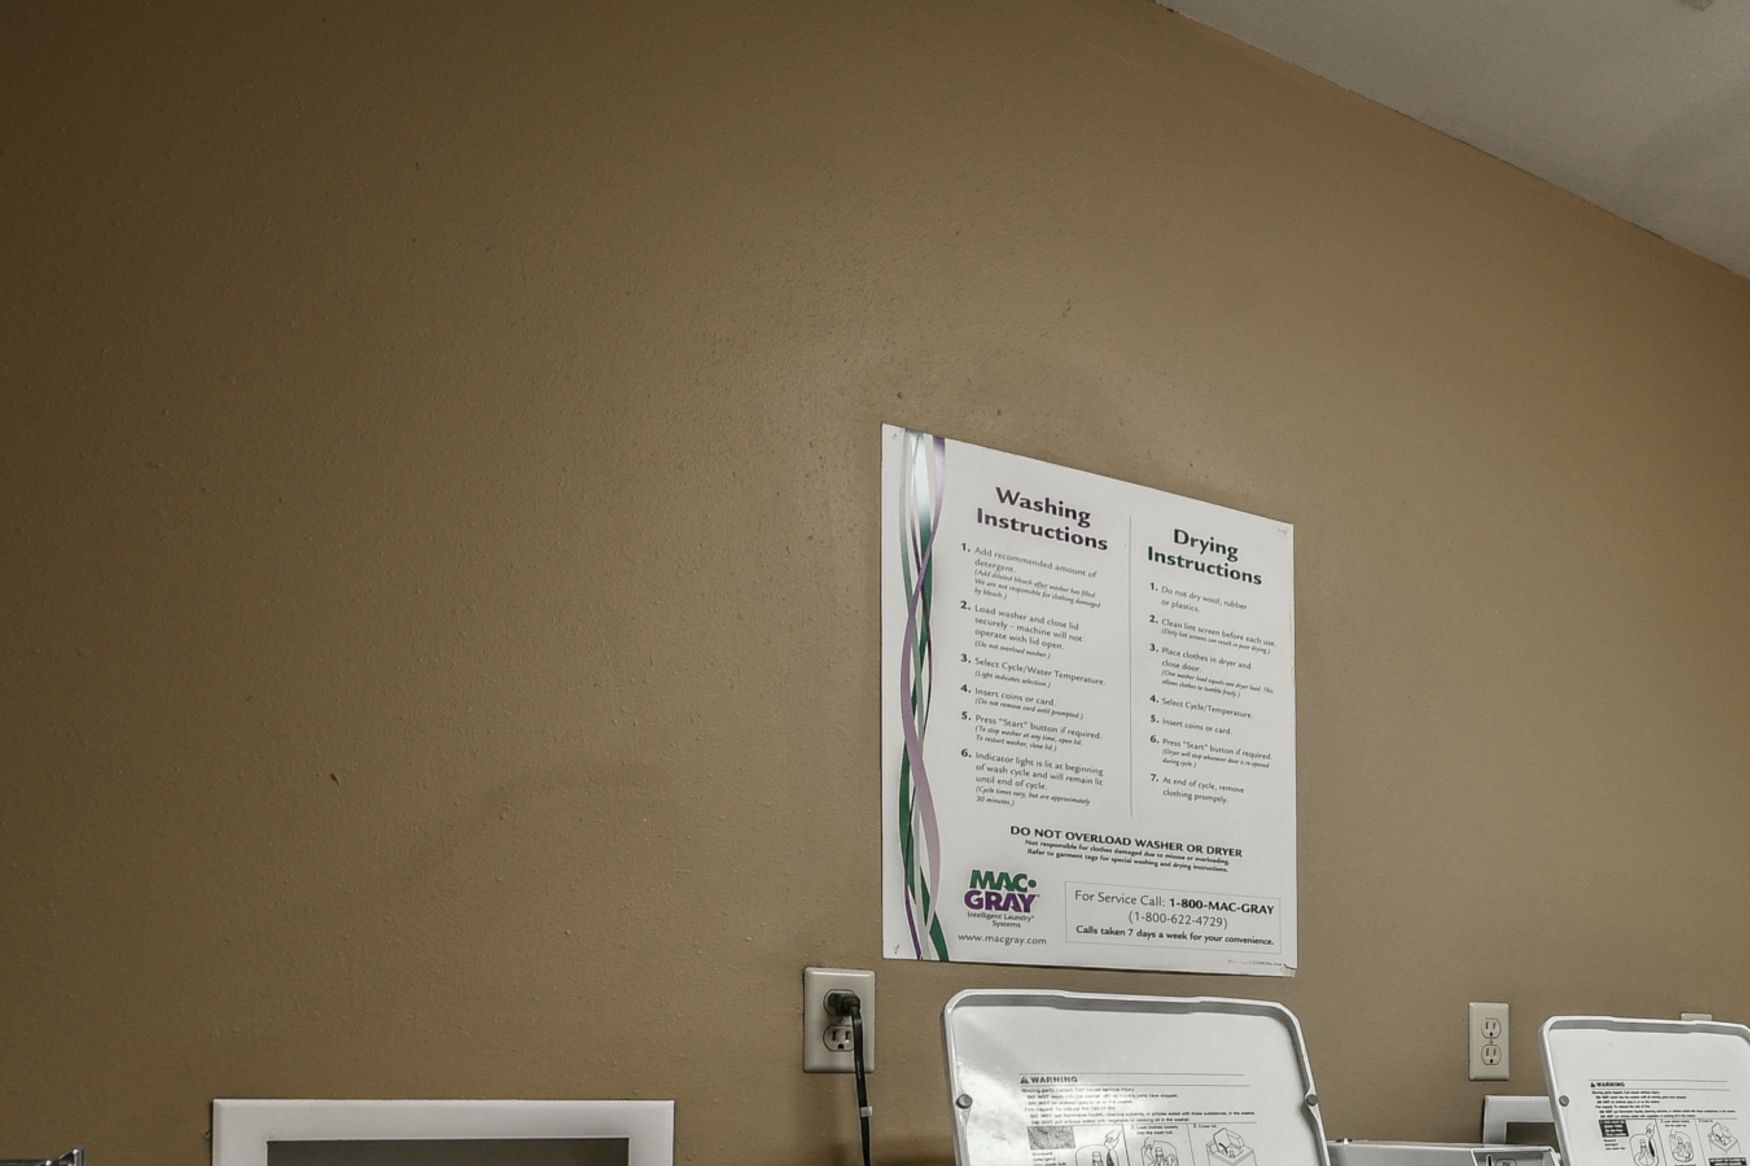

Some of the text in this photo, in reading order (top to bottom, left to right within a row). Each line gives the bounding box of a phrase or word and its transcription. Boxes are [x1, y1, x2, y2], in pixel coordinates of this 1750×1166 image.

[995, 487, 1091, 527] Washing
[977, 508, 1108, 550] Instructions
[1173, 529, 1238, 562] Drying
[961, 542, 1097, 578] 1. Add recommended amount of
[1147, 546, 1262, 584] Instructions
[1150, 582, 1247, 610] 1. Do not dry wool, rubber
[960, 600, 1079, 631] 2. Load washer and close lid
[974, 617, 1082, 642] securely machine will not
[974, 629, 1007, 640] operate
[1008, 635, 1027, 643] with
[1029, 636, 1040, 645] lid
[1149, 614, 1159, 624] 2.
[1161, 618, 1183, 628] Clean
[1183, 622, 1196, 631] lint
[1197, 627, 1220, 636] screen
[1221, 629, 1244, 640] before
[1245, 636, 1262, 644] each
[960, 653, 971, 663] 3.
[974, 657, 999, 668] Select
[1001, 661, 1052, 676] Cycle/Water
[1149, 643, 1159, 652] 3.
[1161, 646, 1181, 657] Place
[1182, 650, 1208, 662] clothes
[1218, 657, 1236, 667] dryer
[1237, 662, 1251, 670] and
[1161, 659, 1180, 669] close
[960, 683, 971, 693] 4.
[974, 687, 999, 698] Insert
[1000, 692, 1023, 701] coins
[1149, 694, 1159, 703] 4.
[1161, 697, 1183, 707] Select
[960, 710, 971, 721] 5.
[975, 714, 997, 725] Press
[1029, 722, 1058, 733] button
[1059, 726, 1067, 734] if
[1150, 714, 1159, 723] 5.
[1162, 718, 1183, 727] Insert
[1184, 722, 1204, 731] coins
[1149, 734, 1159, 744] 6.
[1162, 737, 1181, 747] Press
[1209, 744, 1234, 754] button
[960, 748, 971, 758] 6.
[975, 751, 1014, 763] Indicator
[1015, 756, 1034, 767] light
[1044, 760, 1052, 769] lit
[1064, 763, 1104, 777] beginning
[975, 763, 986, 771] of
[986, 766, 1008, 774] wash
[1009, 768, 1030, 777] cycle
[1031, 771, 1048, 779] and
[1065, 775, 1093, 784] remain
[1094, 777, 1103, 786] lit
[975, 776, 995, 784] until
[996, 778, 1013, 786] end
[1014, 779, 1025, 787] of
[1150, 773, 1159, 782] 7.
[1162, 776, 1171, 784] At
[1188, 779, 1197, 787] of
[1197, 782, 1217, 791] cycle,
[1218, 785, 1244, 793] remove
[1162, 788, 1193, 801] clothing
[1010, 825, 1242, 857] DO NOT OVERLOAD WASHER OR DRYER
[963, 890, 1037, 913] GRAY
[1075, 889, 1274, 914] For Service Call: 1-800-MAC-GRAY
[967, 910, 1001, 922] Intelligent
[992, 920, 1021, 928] Systems
[1128, 911, 1228, 929] (1-800-622-4729)
[957, 934, 1047, 946] www.macgray.com
[1075, 924, 1098, 934] Calls
[1100, 926, 1125, 936] taken
[1128, 928, 1134, 936] 7
[1135, 929, 1156, 940] days
[1165, 931, 1187, 940] week
[1189, 931, 1202, 941] for
[1204, 935, 1223, 943] your
[1224, 936, 1274, 945] convenience.
[1031, 1076, 1078, 1084] WARNING
